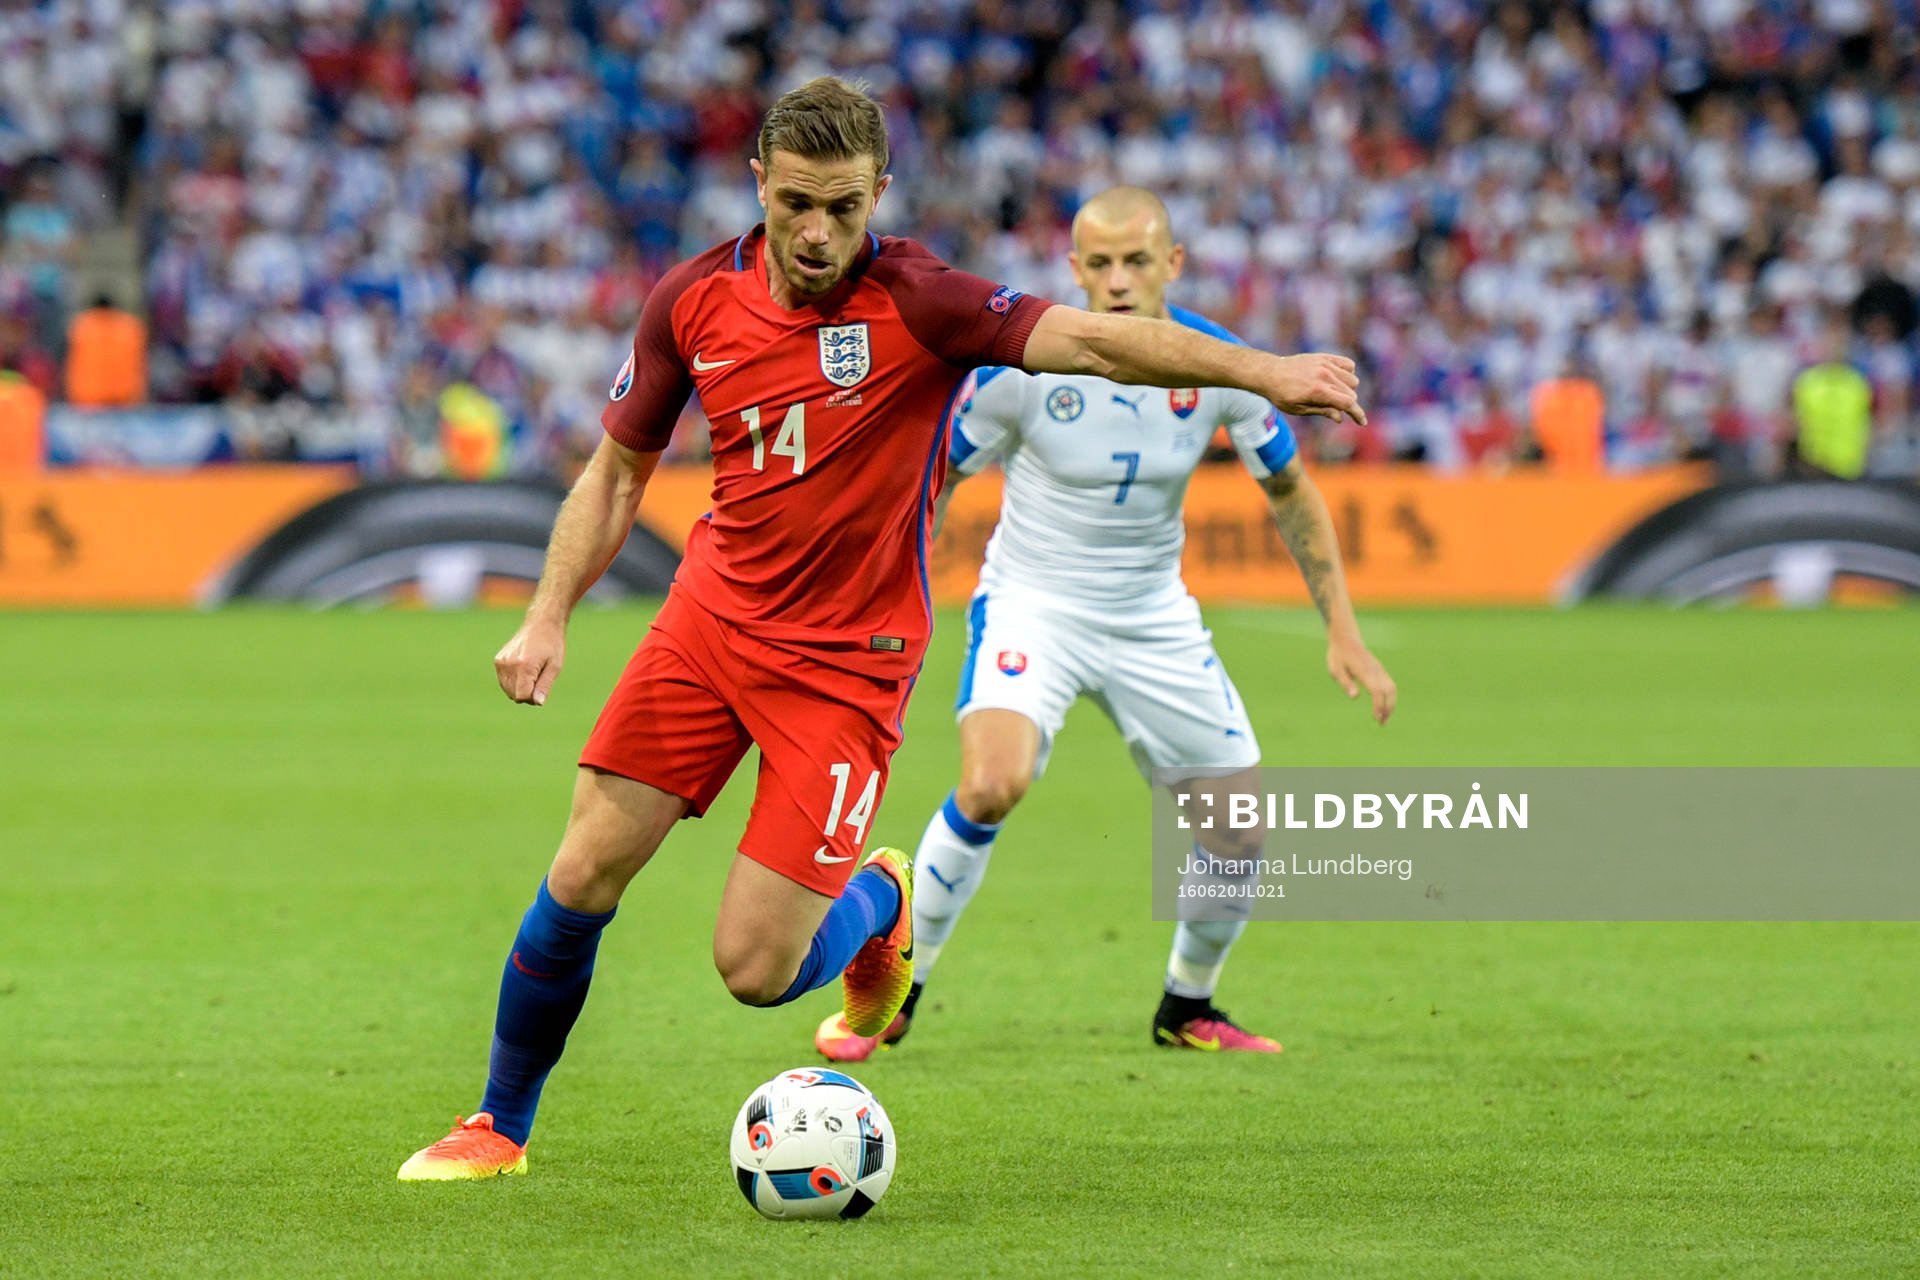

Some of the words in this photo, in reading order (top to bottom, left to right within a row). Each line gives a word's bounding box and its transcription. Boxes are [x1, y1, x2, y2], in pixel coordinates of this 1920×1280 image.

[740, 402, 805, 475] 14
[1111, 451, 1140, 505] 7
[823, 763, 880, 845] 14
